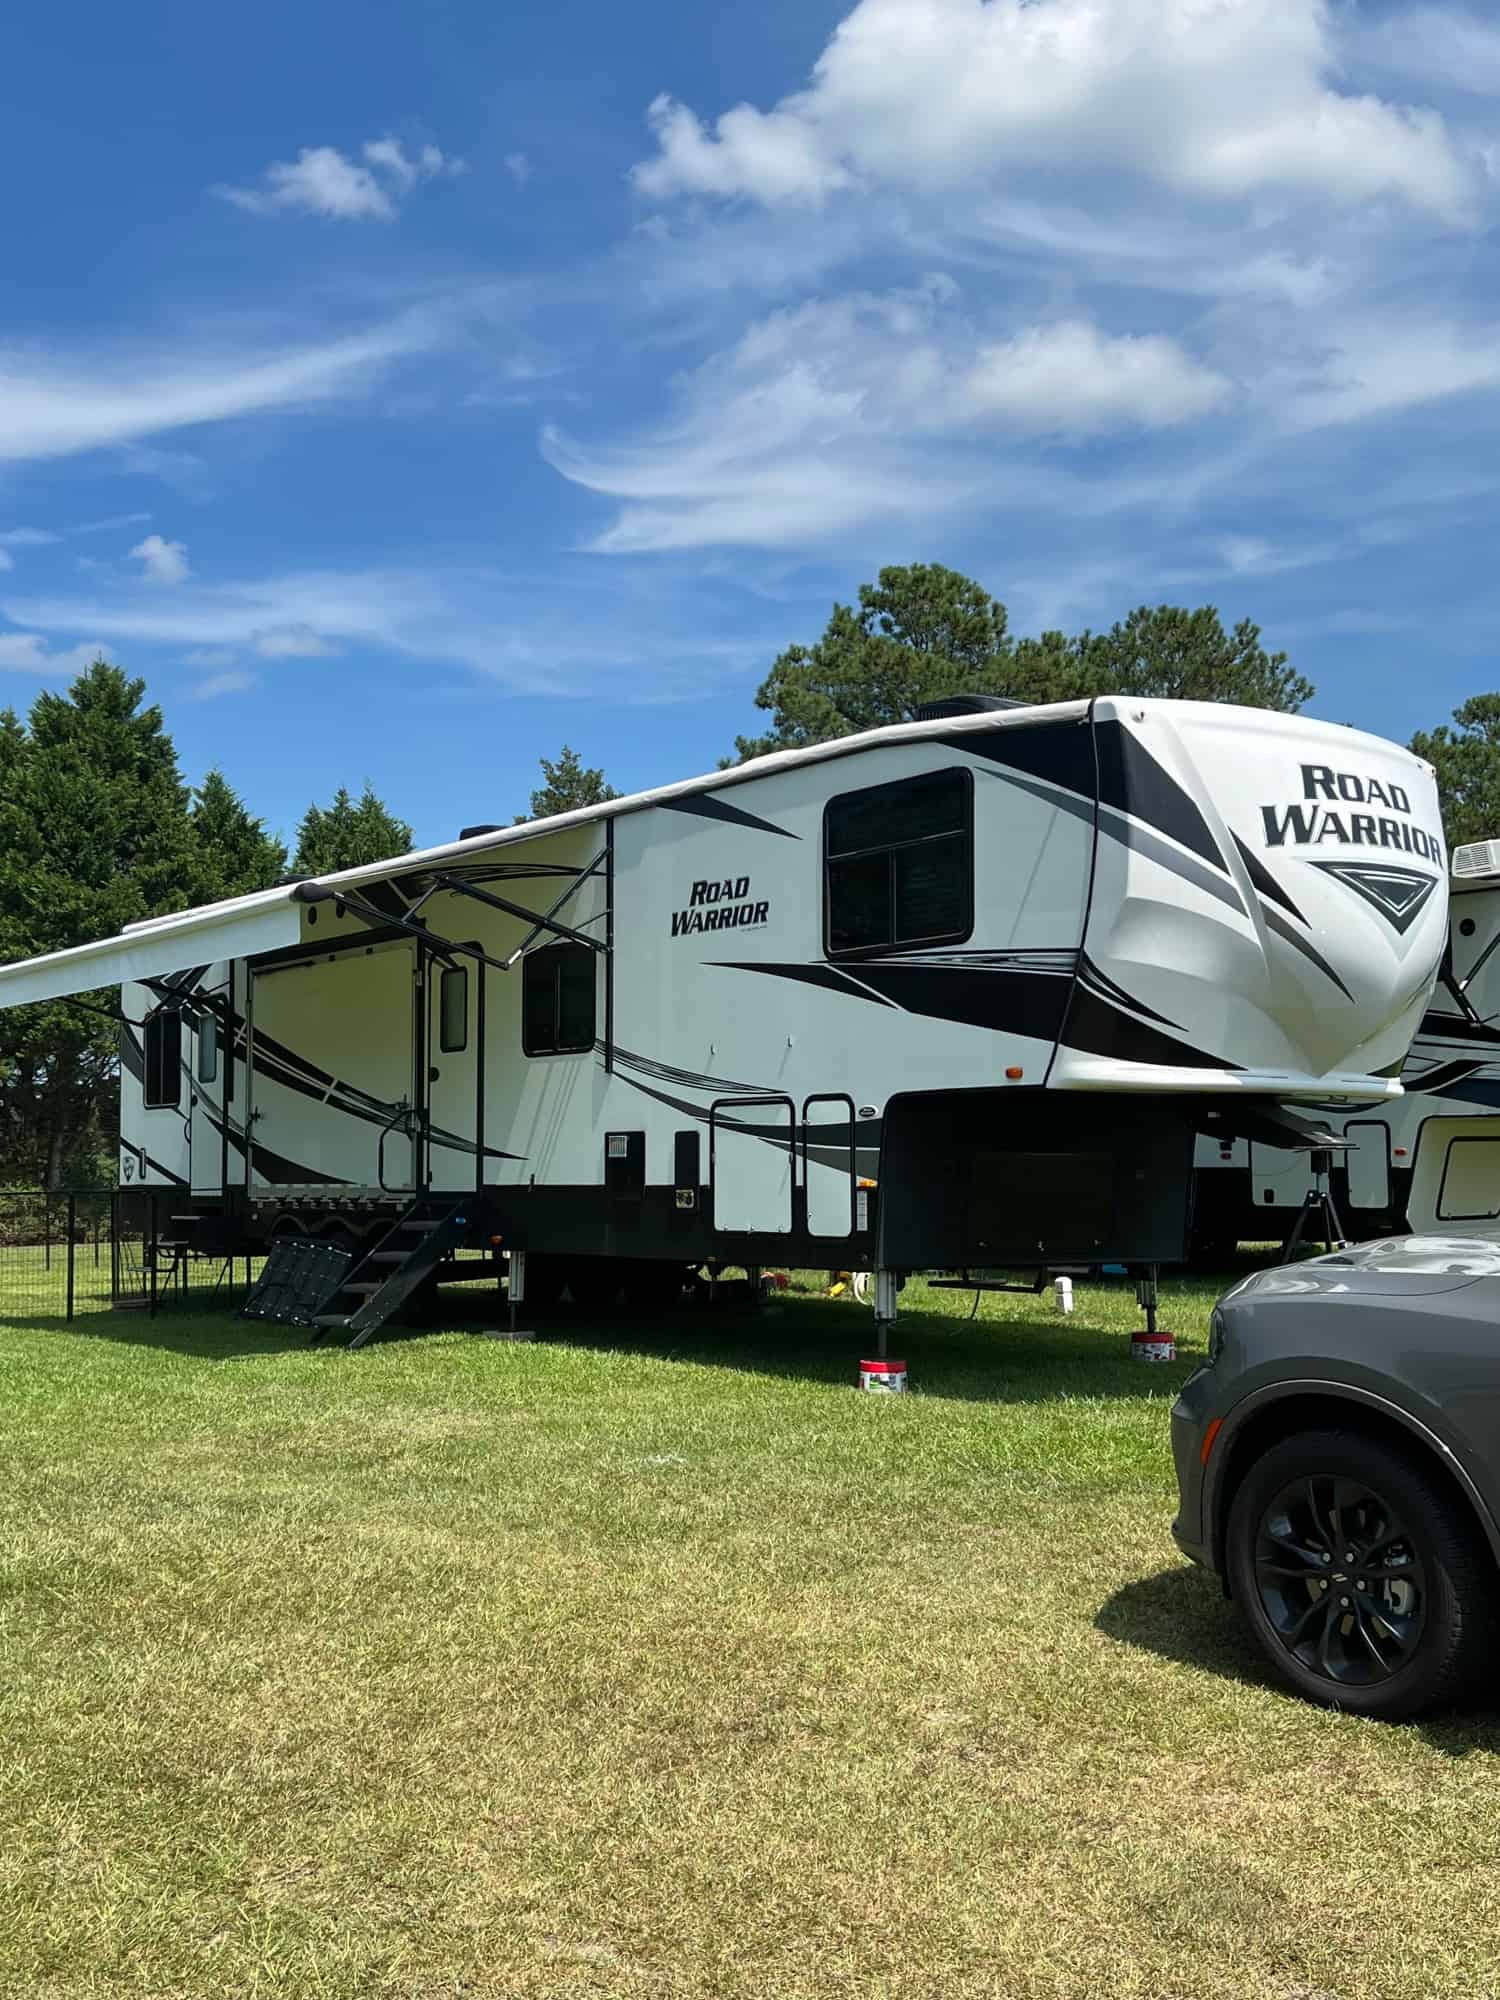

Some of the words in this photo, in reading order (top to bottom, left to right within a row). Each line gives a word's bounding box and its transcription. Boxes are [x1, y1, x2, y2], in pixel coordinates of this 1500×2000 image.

[1300, 764, 1411, 814] ROAD
[1261, 804, 1443, 869] WARRIOR
[689, 876, 750, 907] ROAD
[671, 901, 769, 937] WARRIOR
